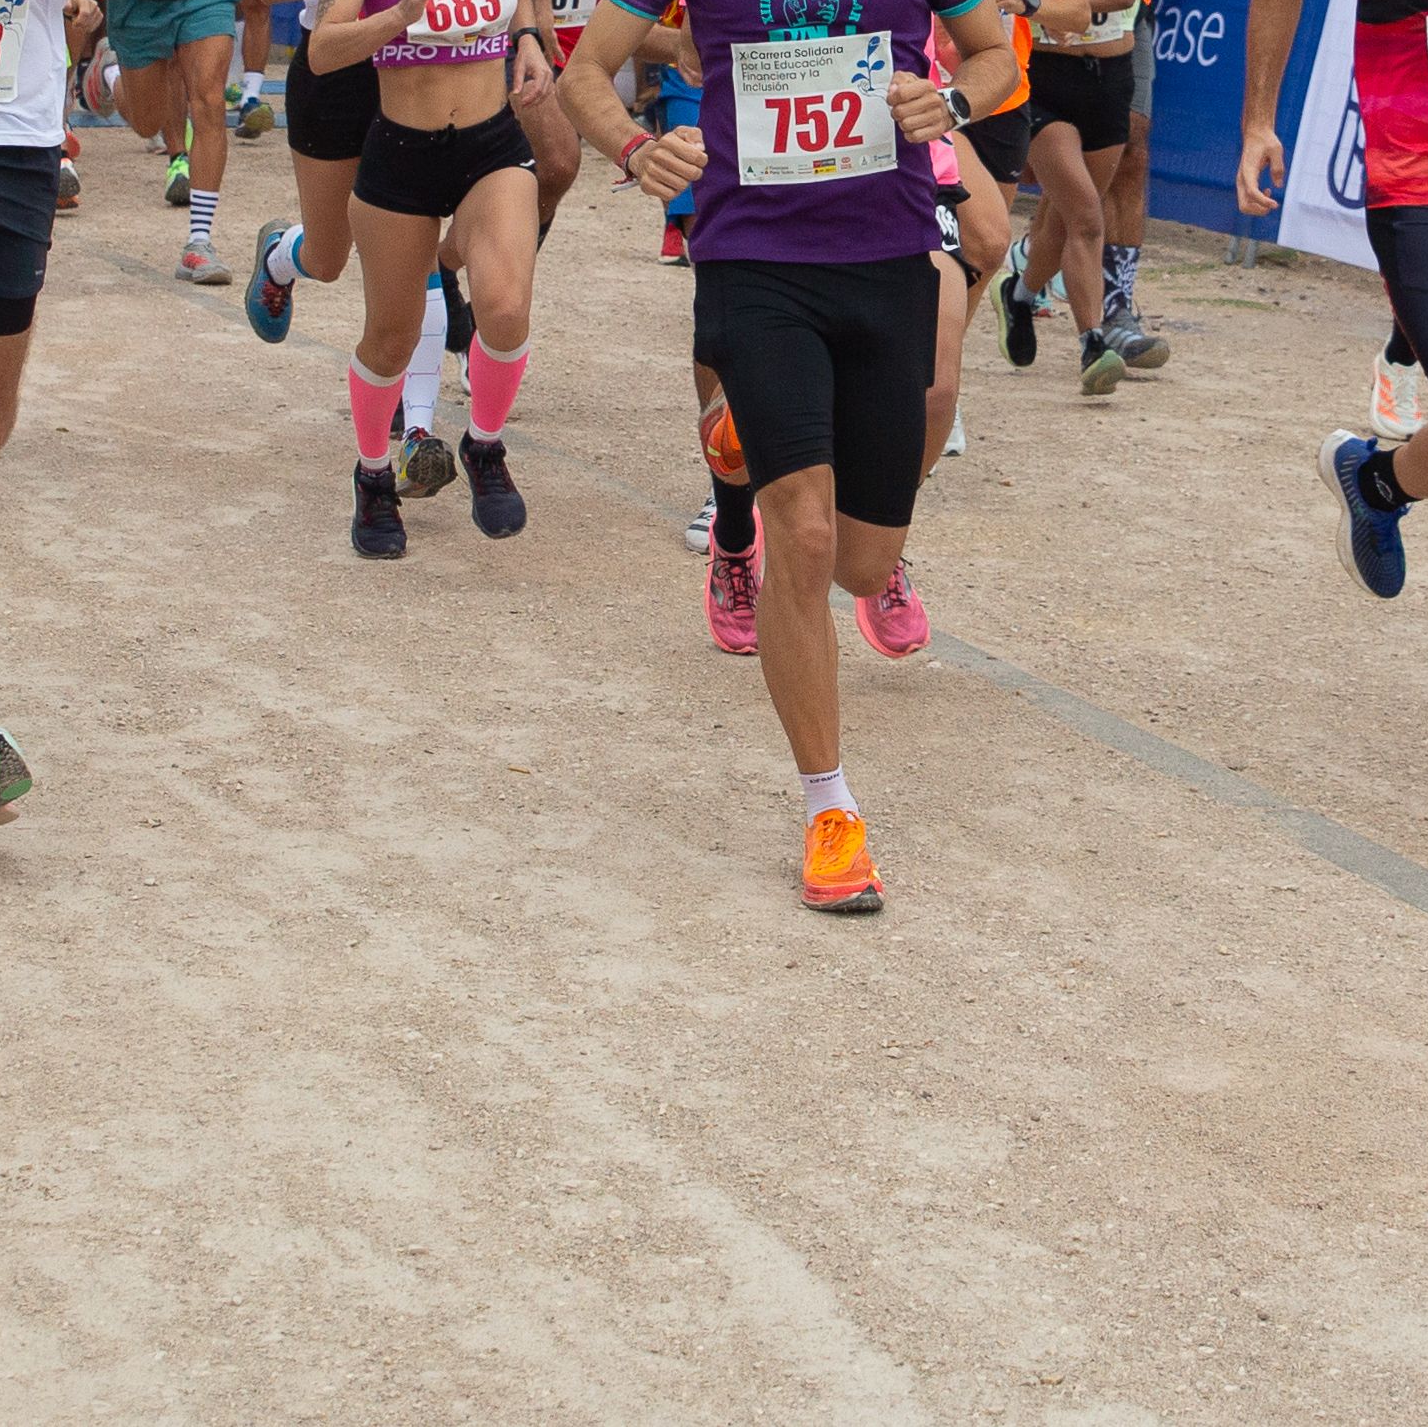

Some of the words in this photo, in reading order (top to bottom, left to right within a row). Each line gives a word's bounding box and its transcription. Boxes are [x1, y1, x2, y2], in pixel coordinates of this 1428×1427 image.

[739, 51, 748, 60] X
[750, 50, 791, 60] Carrera
[794, 45, 844, 58] Solidaria
[741, 63, 758, 72] por
[761, 61, 771, 70] la
[774, 56, 833, 70] Educación
[742, 71, 797, 81] Financiera
[800, 72, 807, 80] y
[809, 69, 820, 78] la
[742, 81, 789, 92] Inclusión
[764, 91, 864, 154] 752
